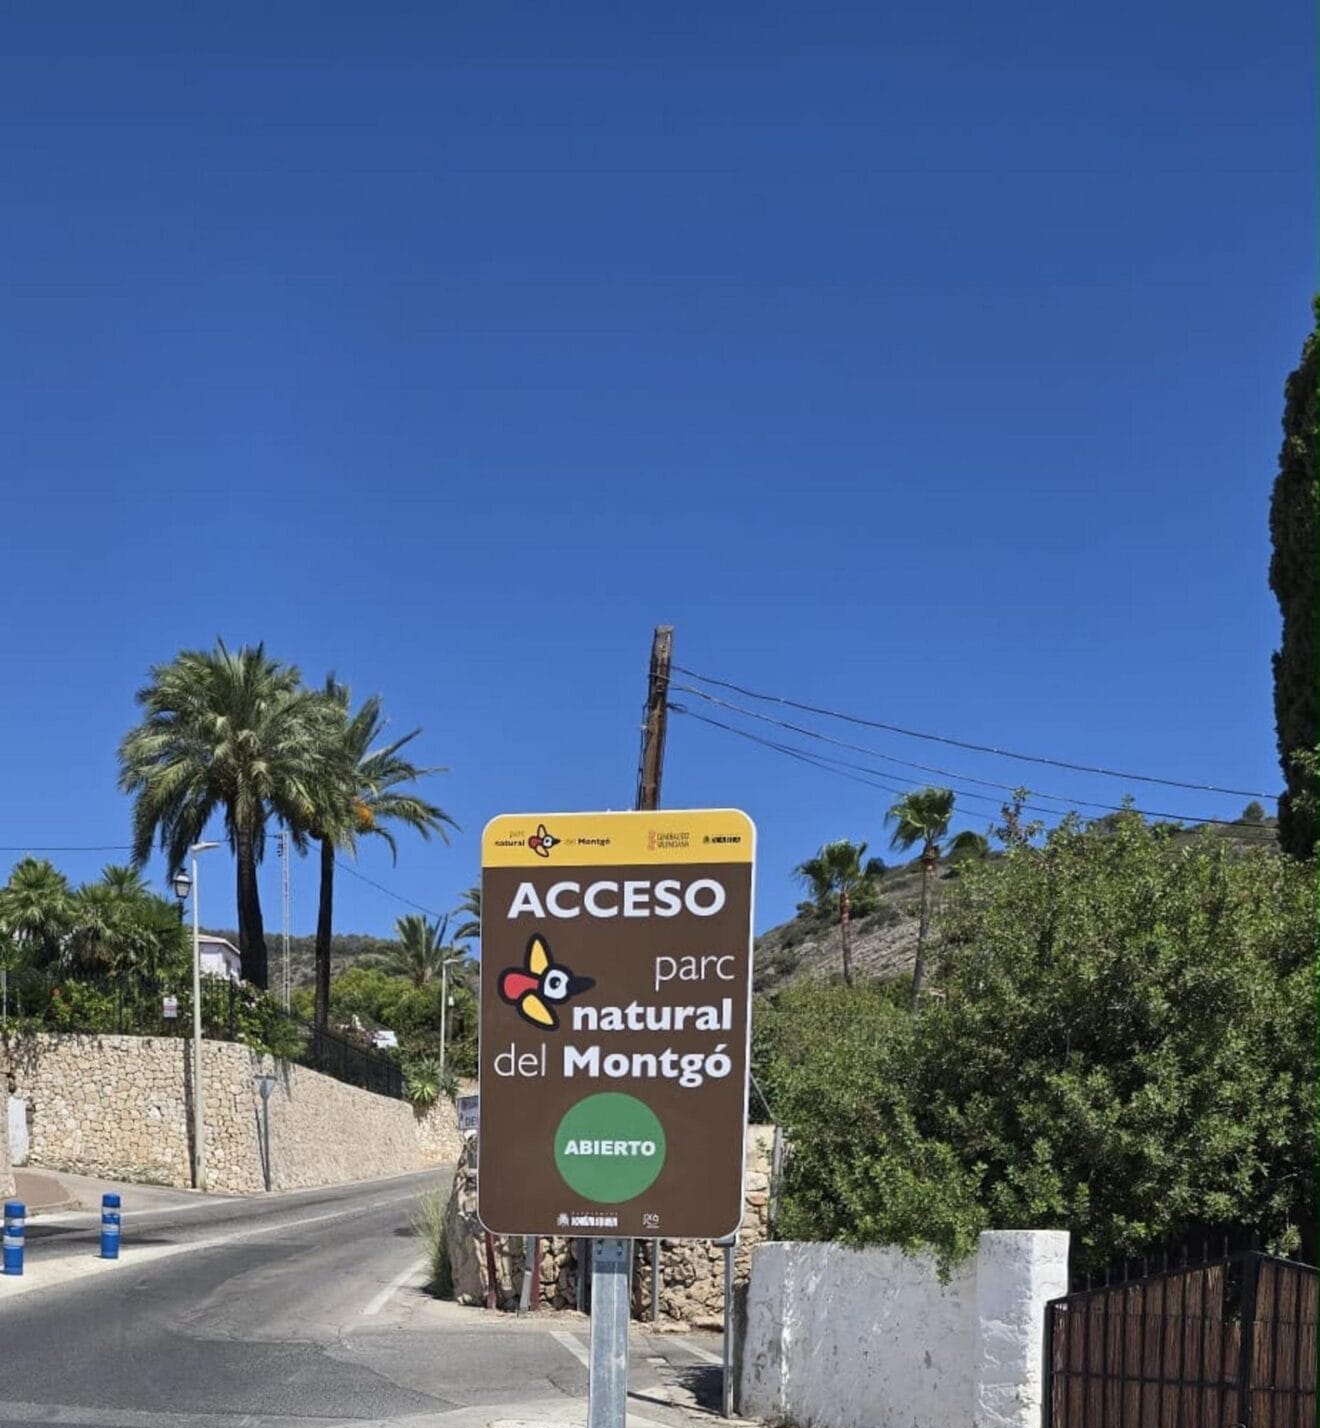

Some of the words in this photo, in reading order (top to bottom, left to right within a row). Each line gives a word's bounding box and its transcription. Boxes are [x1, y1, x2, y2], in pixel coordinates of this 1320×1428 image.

[507, 878, 726, 919] ACCESO
[655, 955, 735, 992] parc
[572, 997, 733, 1031] natural
[493, 1042, 546, 1077] del
[563, 1043, 732, 1088] Montgó
[564, 1140, 656, 1156] ABIERTO
